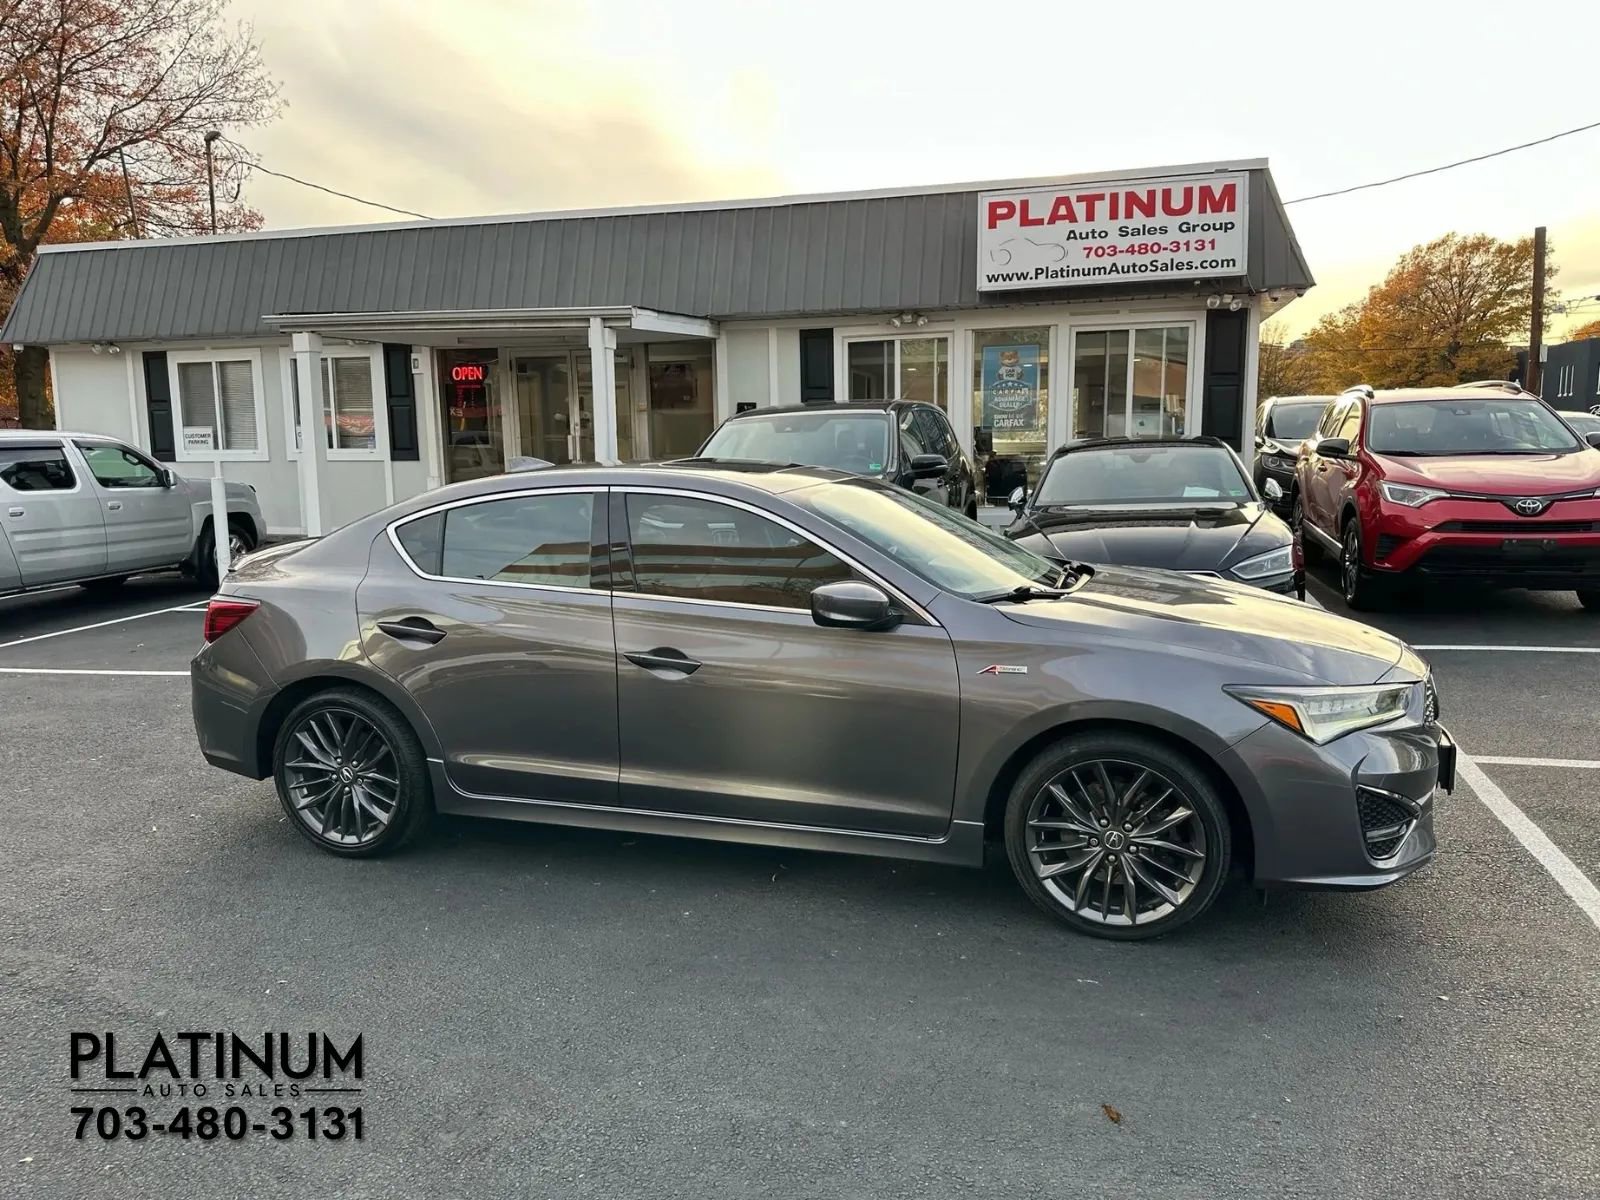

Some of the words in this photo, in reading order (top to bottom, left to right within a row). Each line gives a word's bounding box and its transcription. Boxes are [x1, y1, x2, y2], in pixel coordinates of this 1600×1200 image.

[987, 183, 1237, 230] PLATINUM
[1066, 228, 1109, 242] Auto
[1118, 223, 1169, 238] Sales
[1178, 220, 1236, 235] Group
[1083, 238, 1217, 259] 703-480-3131
[986, 257, 1237, 283] www.PlatinumAutoSales.com
[452, 366, 483, 381] OPEN
[993, 418, 1024, 427] CARFAX
